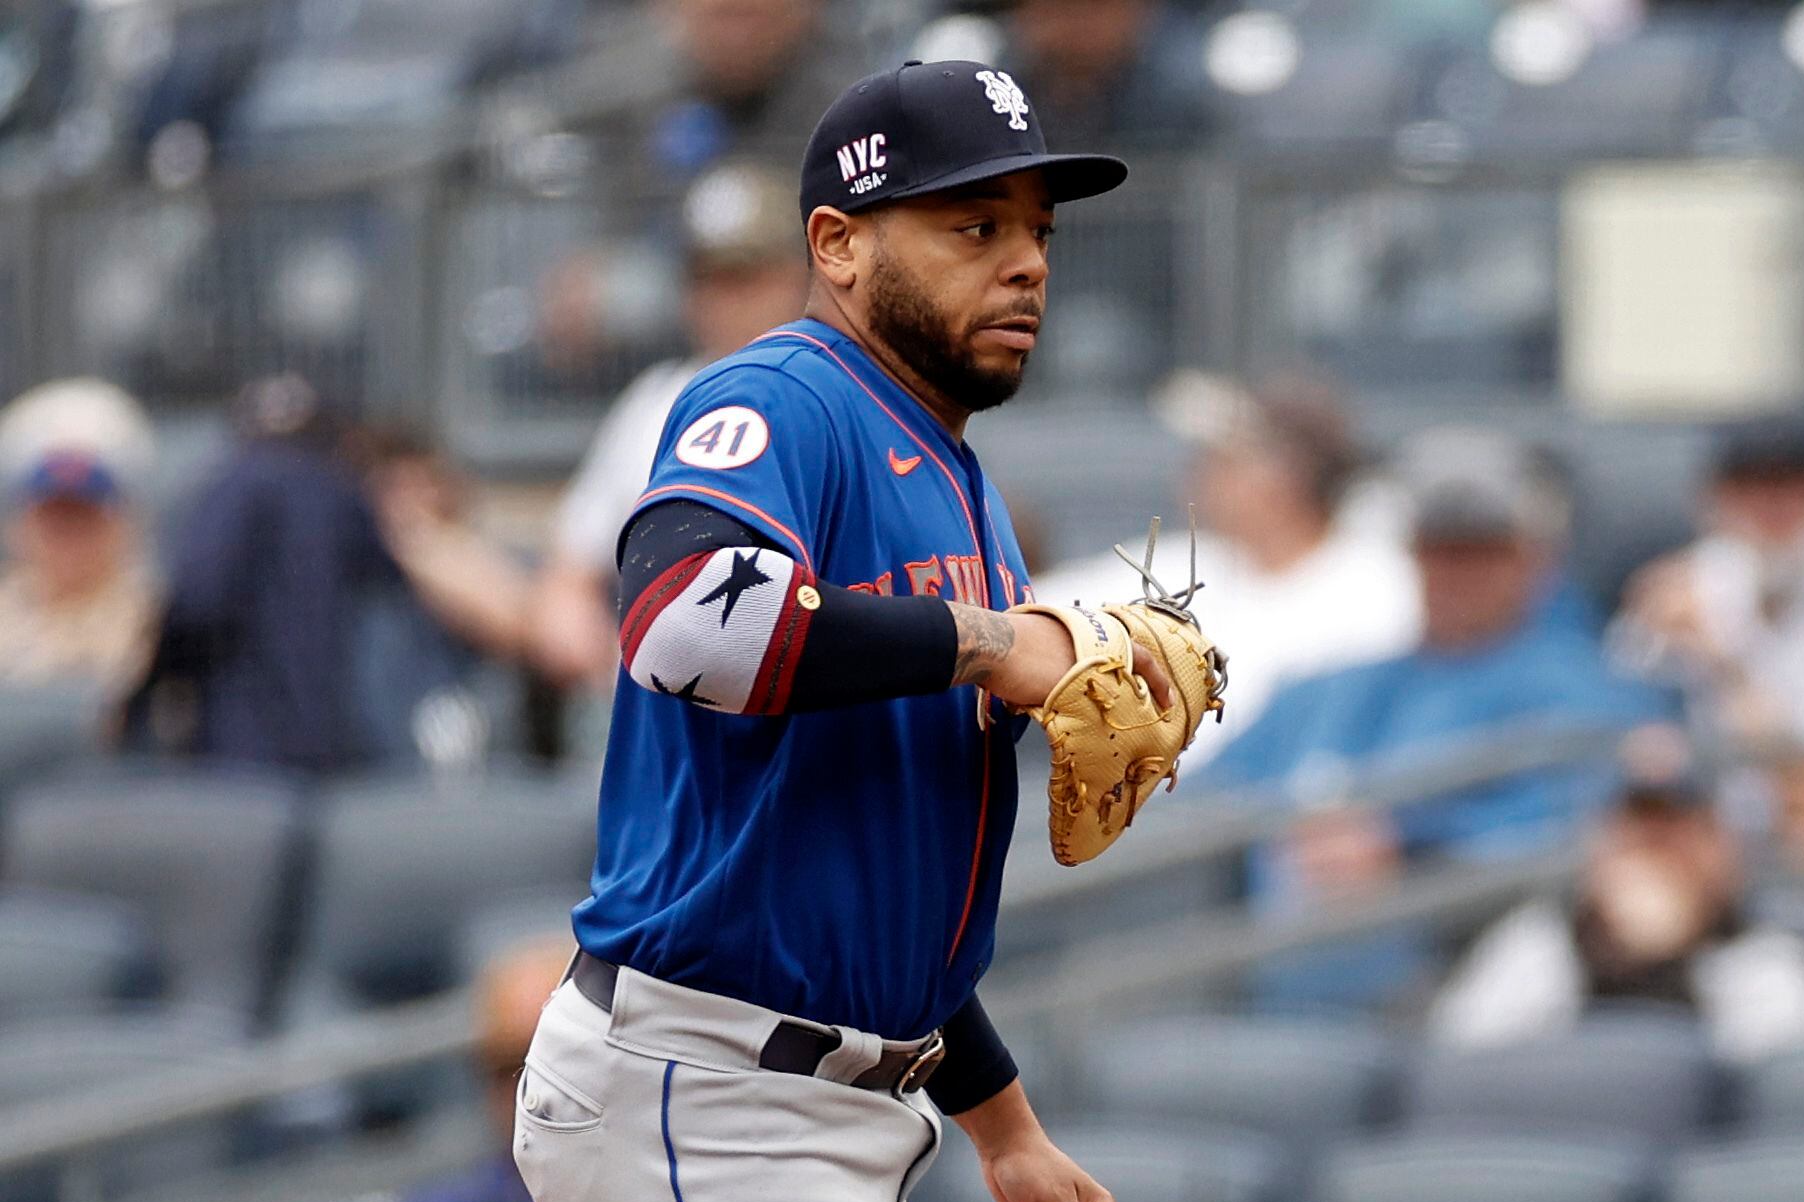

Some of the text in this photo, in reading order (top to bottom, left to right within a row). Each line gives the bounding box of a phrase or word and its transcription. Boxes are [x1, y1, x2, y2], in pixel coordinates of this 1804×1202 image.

[837, 133, 886, 182] NYC
[854, 172, 882, 194] USA
[689, 420, 749, 456] 41
